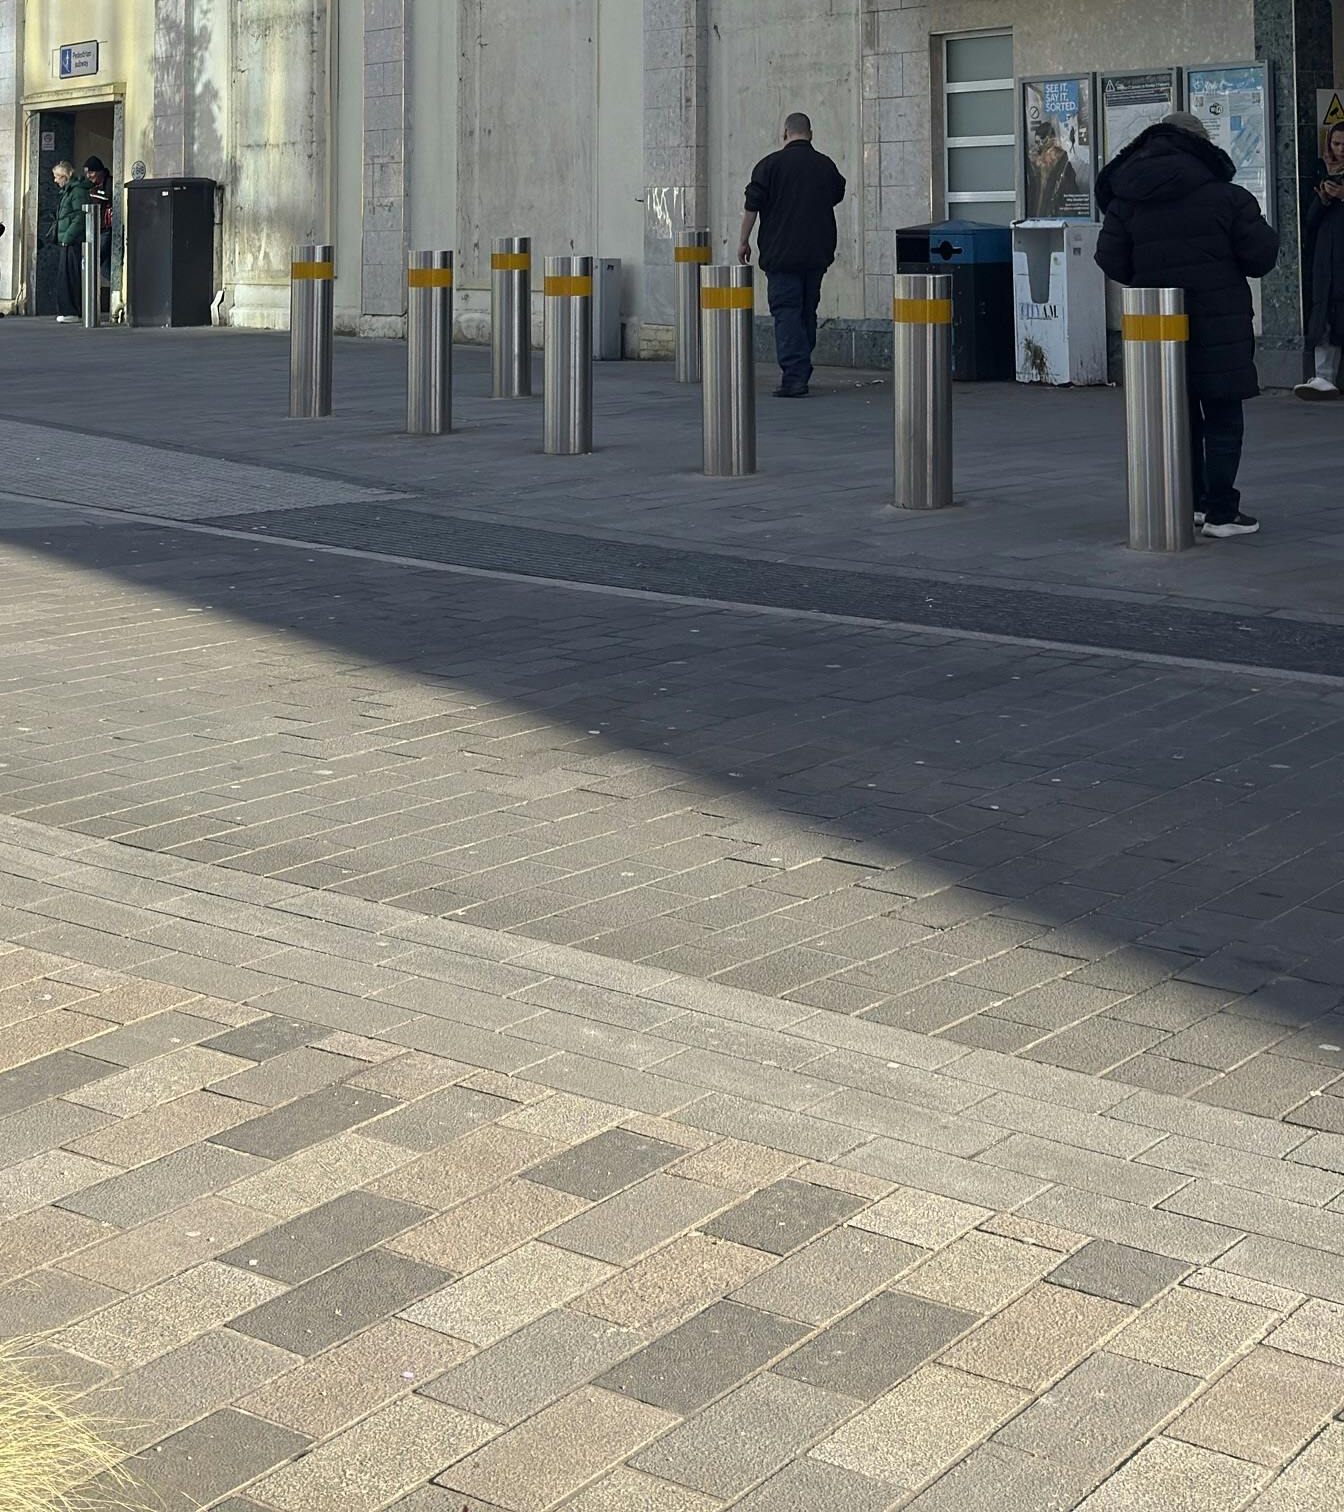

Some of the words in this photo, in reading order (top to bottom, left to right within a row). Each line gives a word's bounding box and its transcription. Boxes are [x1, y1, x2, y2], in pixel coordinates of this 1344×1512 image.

[1046, 84, 1059, 93] SEE
[1060, 83, 1069, 92] IT.
[1046, 93, 1058, 102] SAY
[1059, 92, 1069, 101] IT.
[1046, 102, 1078, 112] SORTED.
[1019, 304, 1040, 319] CITY
[1043, 304, 1059, 319] A.M.
